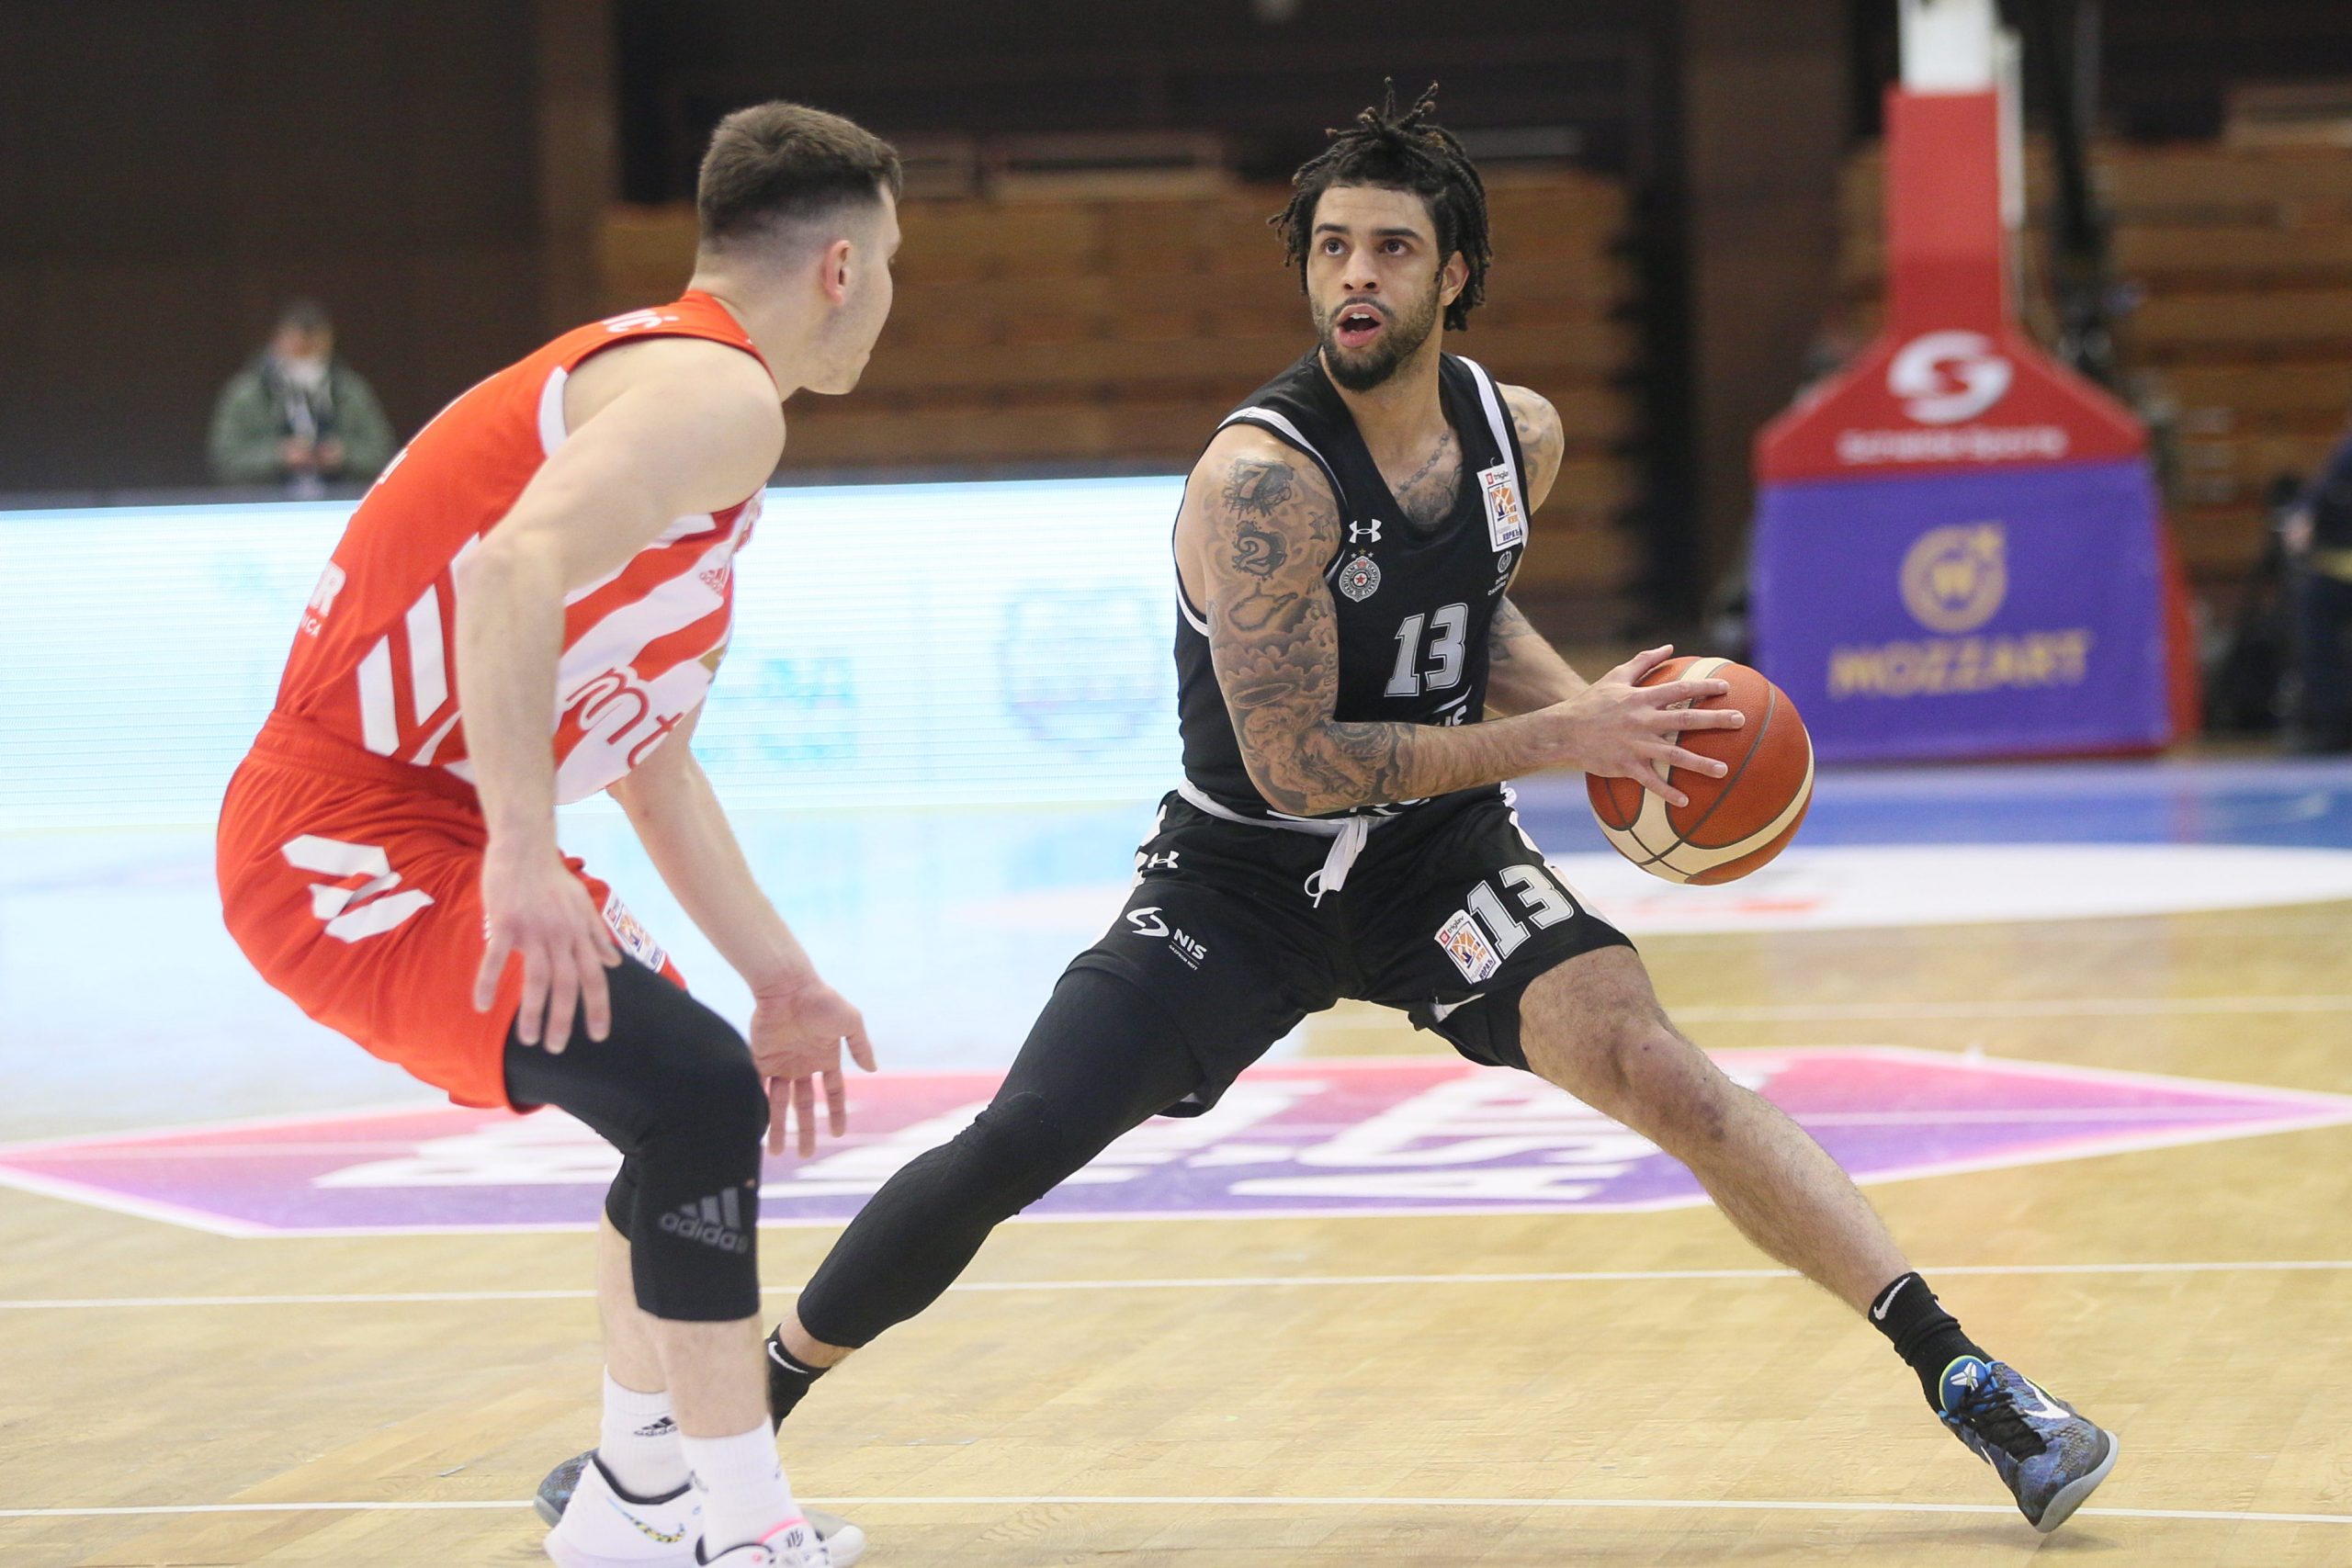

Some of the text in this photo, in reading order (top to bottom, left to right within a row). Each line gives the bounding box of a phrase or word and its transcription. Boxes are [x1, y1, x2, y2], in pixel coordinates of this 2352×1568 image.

[1384, 603, 1468, 697] 13
[1827, 630, 2093, 699] MOZZART
[1447, 916, 1464, 934] triglav
[1467, 864, 1575, 959] 13
[1173, 928, 1207, 960] NIS
[660, 1212, 749, 1255] adidas
[633, 1425, 678, 1438] adida
